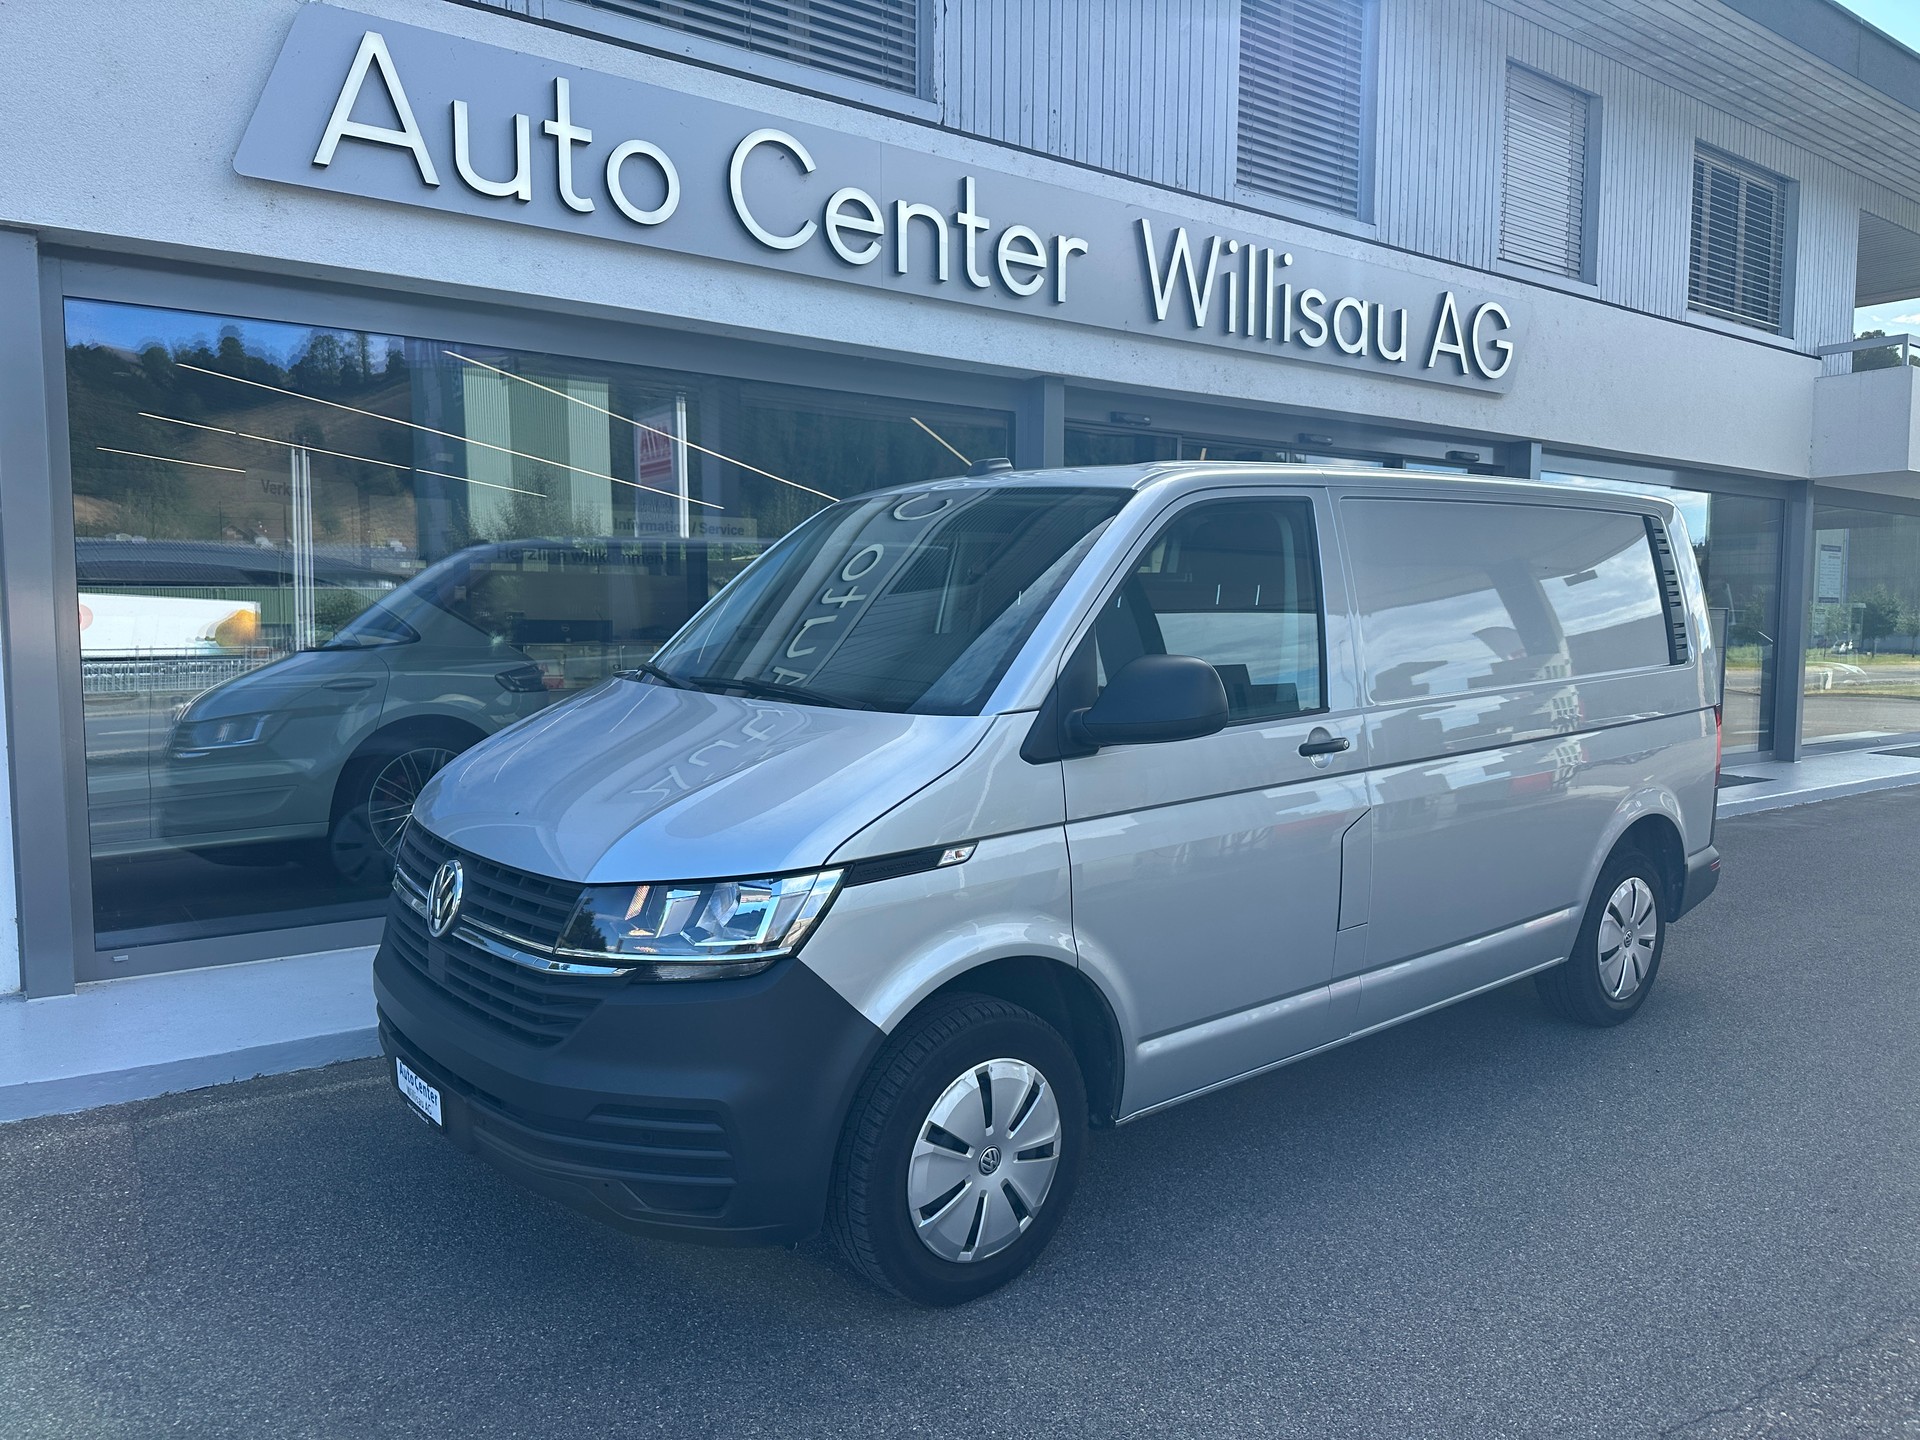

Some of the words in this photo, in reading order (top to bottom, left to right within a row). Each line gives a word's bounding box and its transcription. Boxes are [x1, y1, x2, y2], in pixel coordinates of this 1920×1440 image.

[313, 30, 681, 226] Auto
[729, 128, 1089, 303] Center
[1138, 217, 1407, 363] Willisau
[1426, 290, 1515, 380] AG
[699, 521, 745, 537] Service
